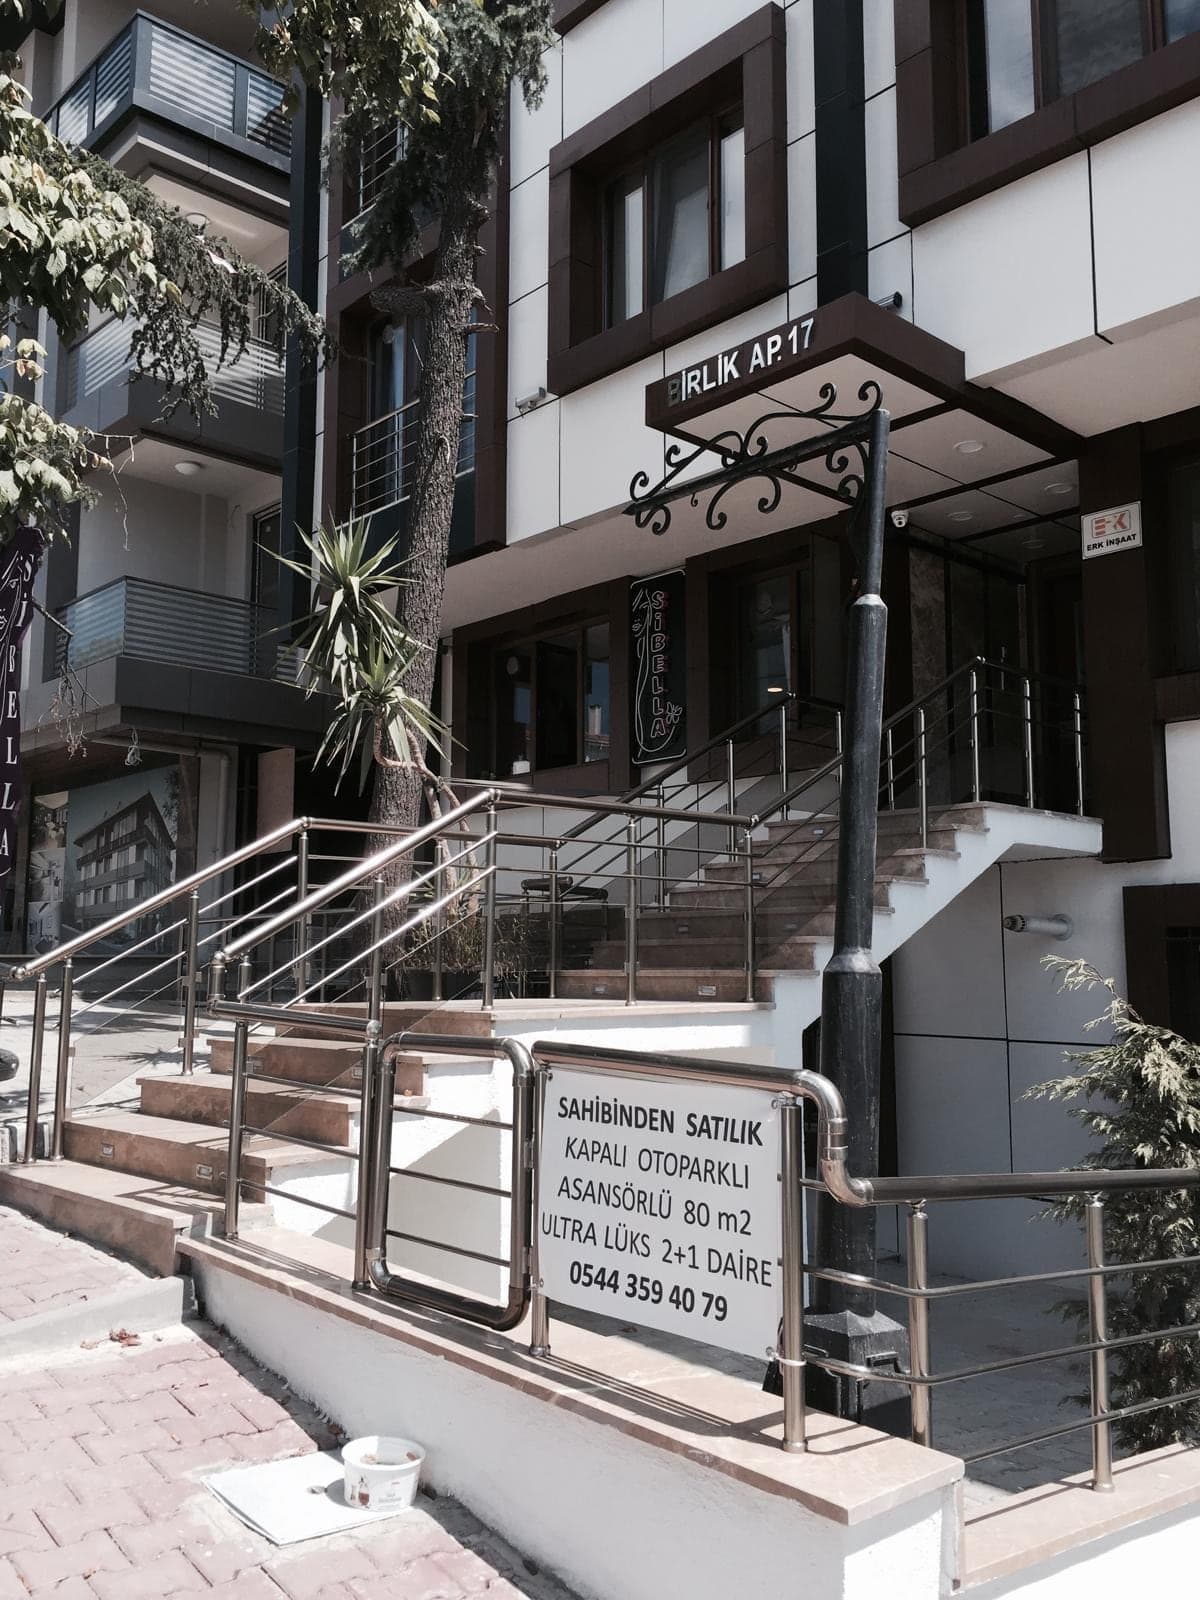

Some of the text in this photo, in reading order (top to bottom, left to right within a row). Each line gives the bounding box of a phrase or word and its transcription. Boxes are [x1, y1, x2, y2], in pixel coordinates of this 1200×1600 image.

[668, 350, 740, 407] BİRLİK
[1087, 533, 1137, 551] ERK İNŞAAT
[557, 1095, 764, 1146] SAHİBİNDEN SATILIK
[564, 1136, 749, 1189] KAPALI OTOPARKLI
[557, 1175, 752, 1236] ASANSÖRLÜ 80 m2
[541, 1211, 773, 1288] ULTRA LÜKS 2+1 DAİRE
[569, 1260, 728, 1322] 0544 359 40 79
